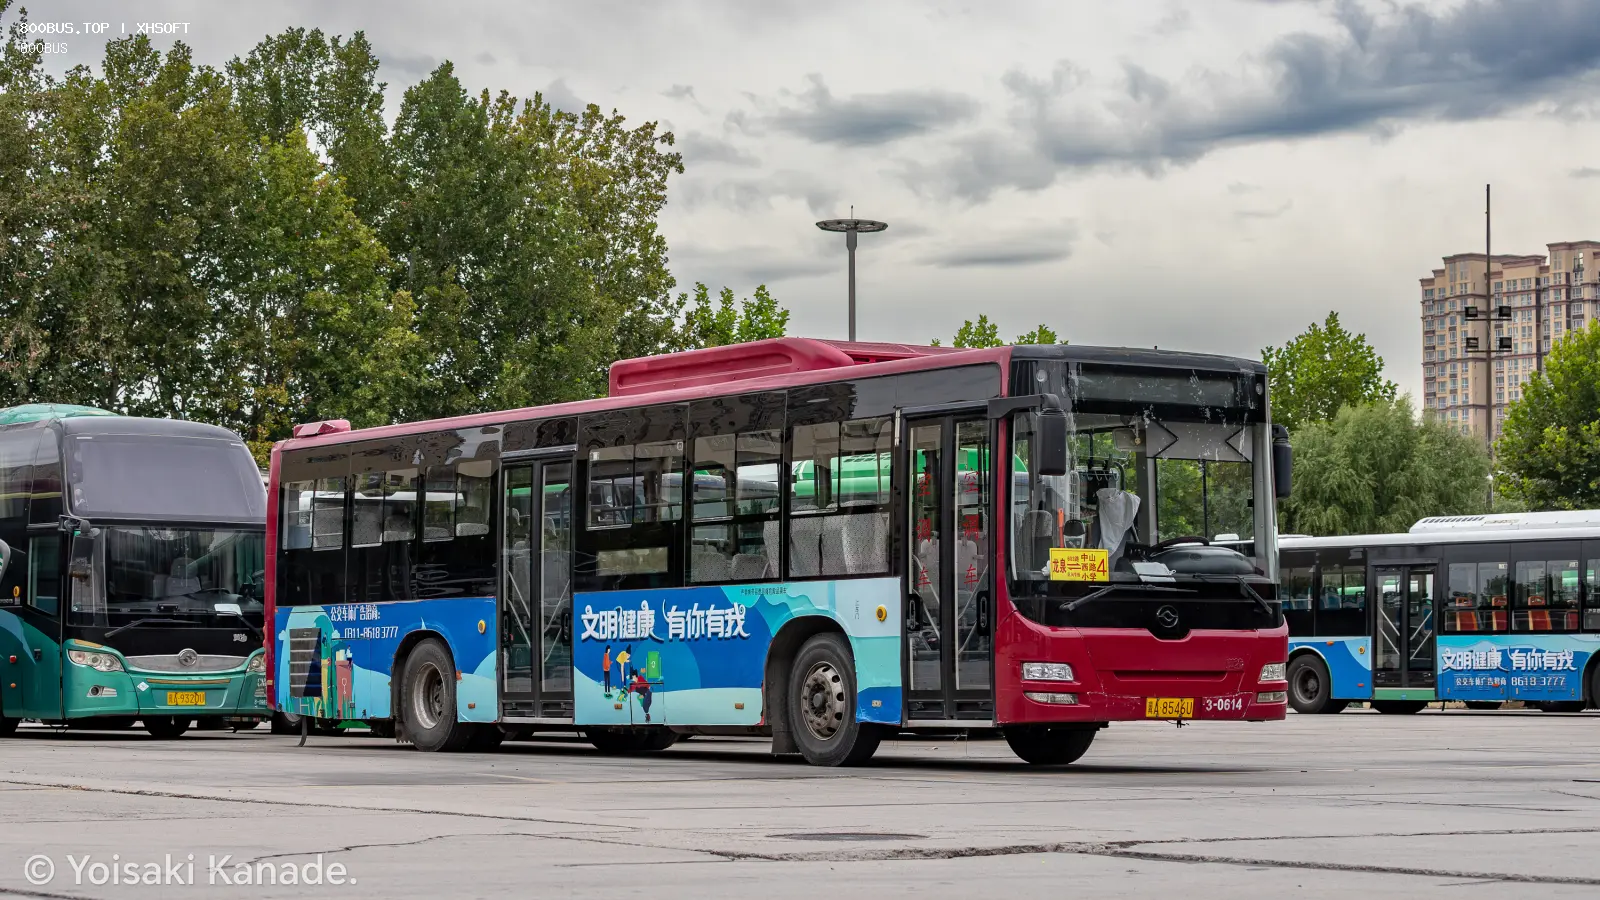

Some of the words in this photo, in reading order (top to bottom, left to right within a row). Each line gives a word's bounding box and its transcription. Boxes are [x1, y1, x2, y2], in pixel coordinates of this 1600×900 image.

[963, 468, 979, 591] 空调车
[1080, 553, 1096, 562] 中山
[1052, 558, 1067, 573] 龙泉
[1081, 563, 1096, 572] 西路
[1096, 558, 1107, 576] 4
[1081, 573, 1097, 582] 小学
[580, 599, 664, 642] 文明健康
[663, 598, 751, 642] 有你有我
[381, 626, 399, 639] 3777
[1441, 646, 1510, 672] 文明健康
[1507, 646, 1577, 672] 有你有我
[1511, 676, 1537, 686] 8618
[1539, 676, 1565, 686] 3777
[1205, 698, 1242, 711] 3-0614
